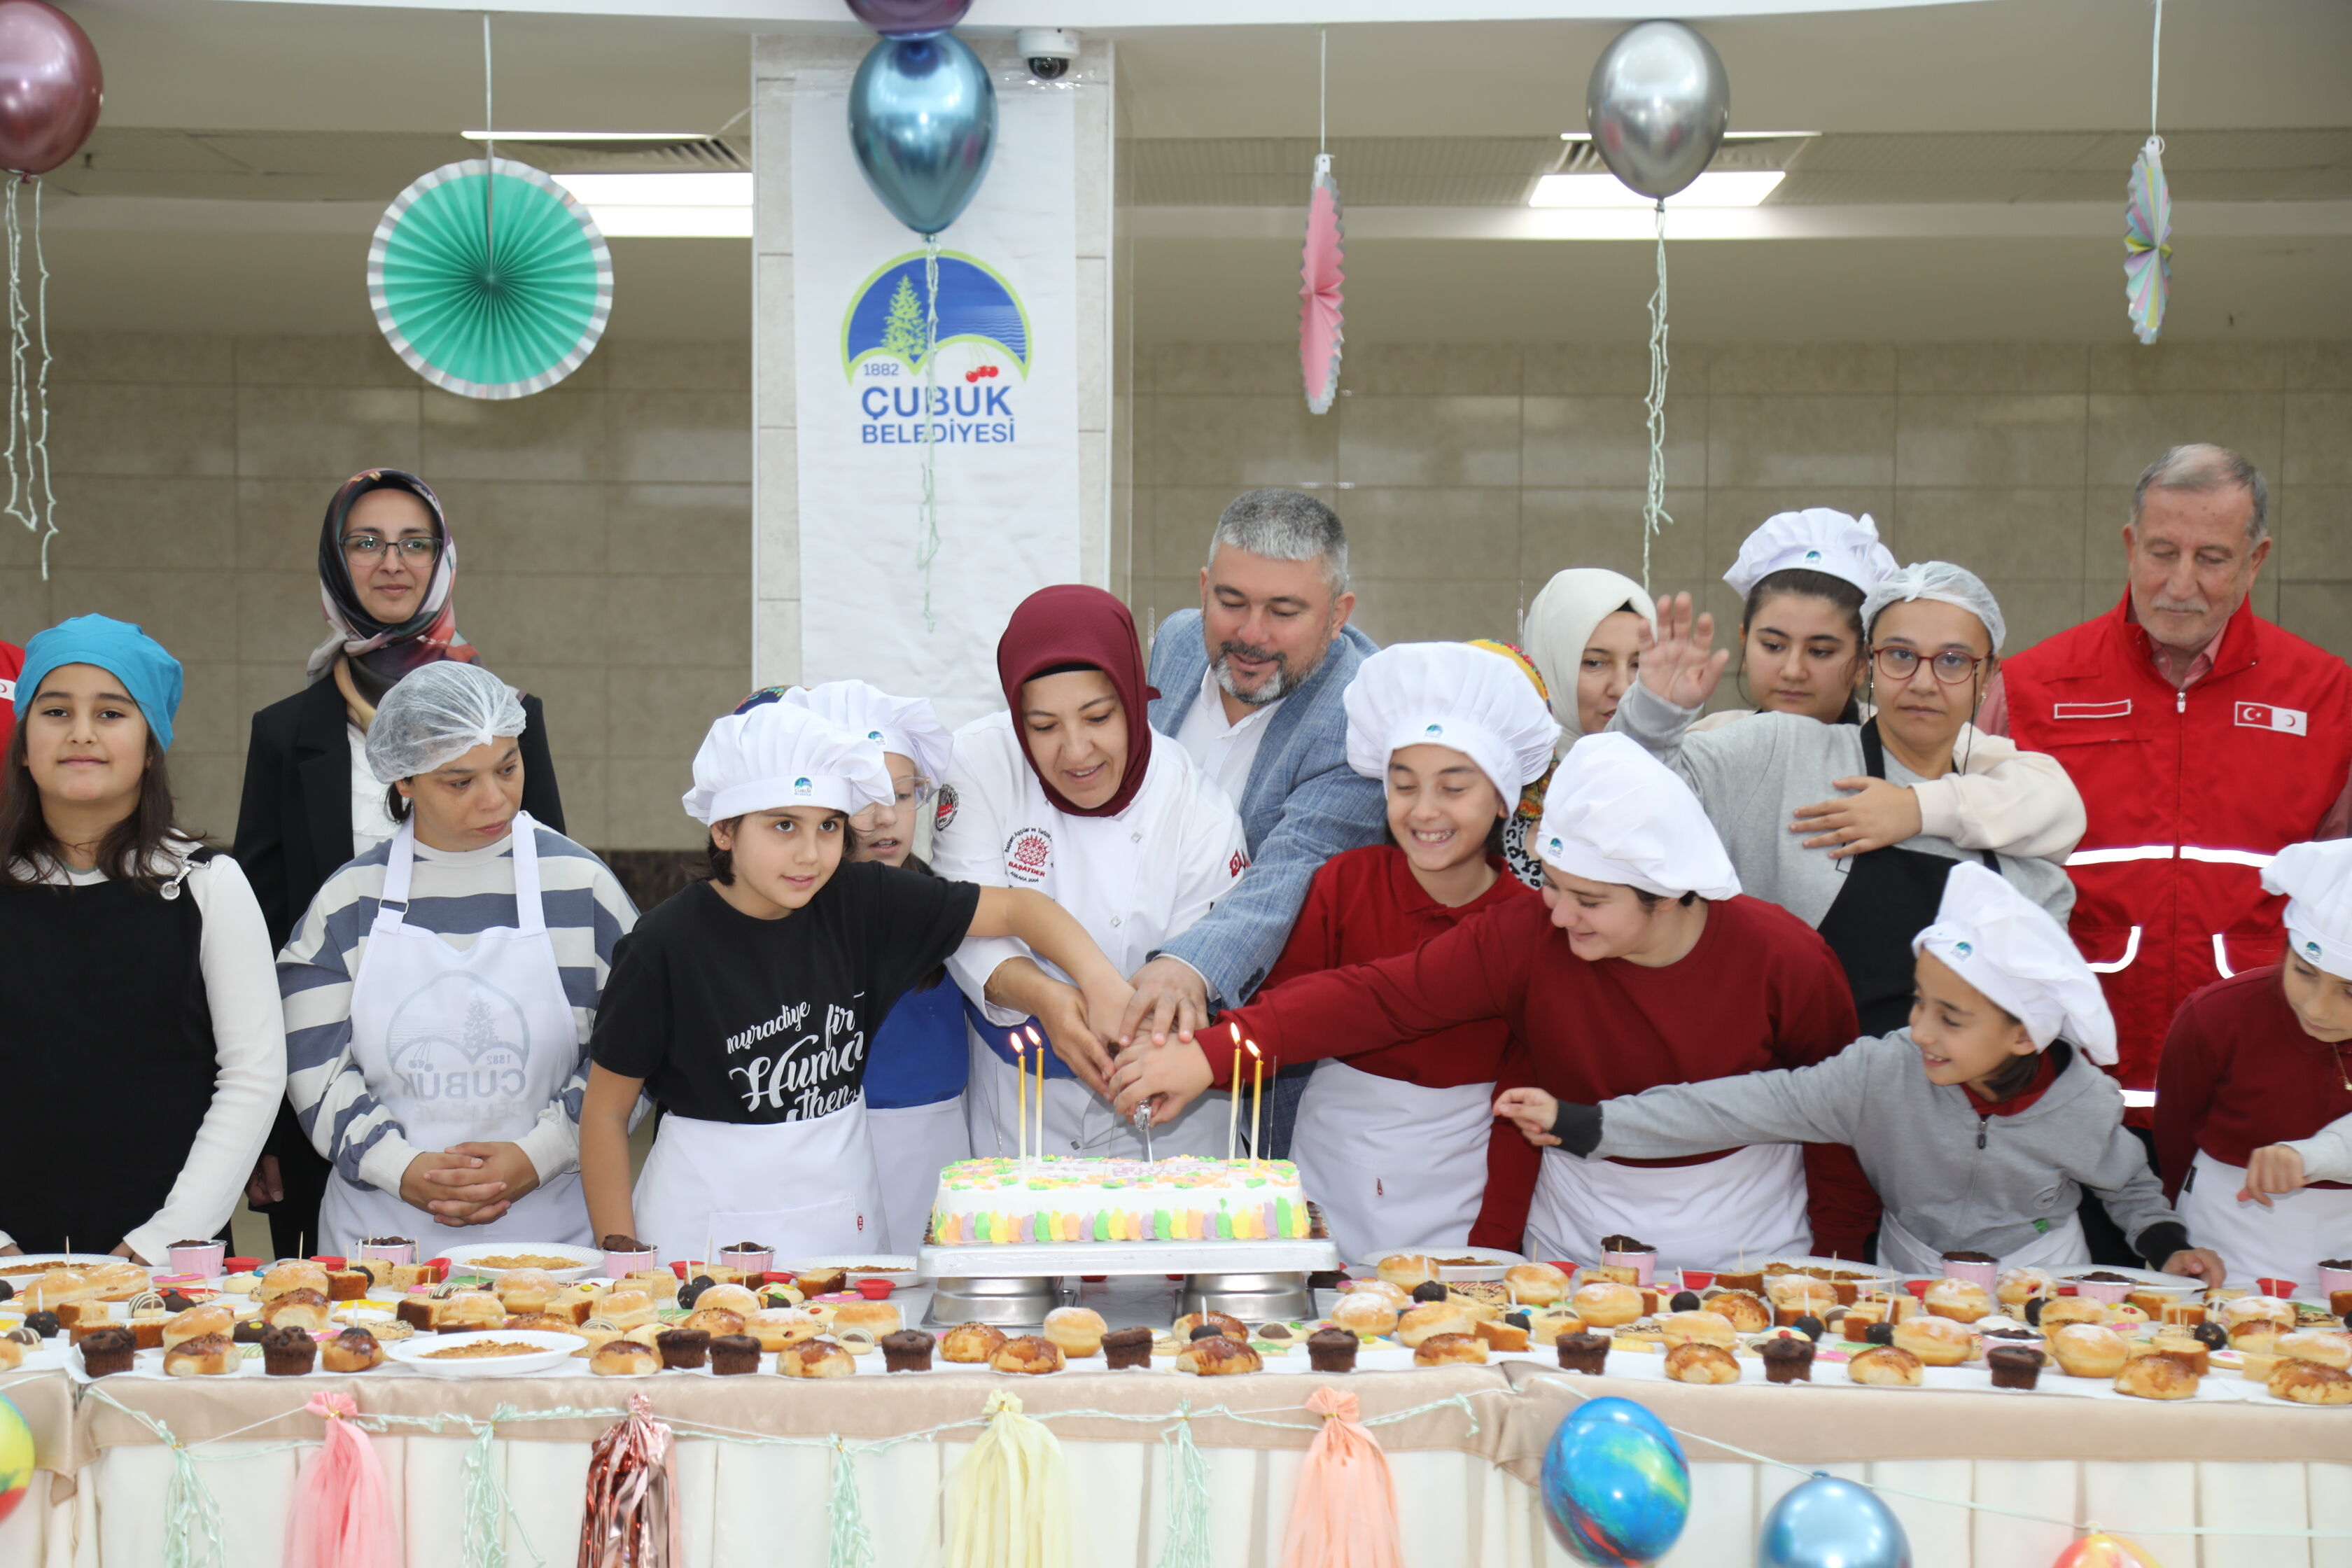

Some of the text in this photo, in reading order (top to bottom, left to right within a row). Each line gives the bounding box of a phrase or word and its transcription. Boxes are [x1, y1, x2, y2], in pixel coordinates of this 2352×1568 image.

[863, 363, 899, 376] 1882
[862, 386, 1013, 421] ÇUBUK
[862, 418, 1015, 443] BELEDİYESİ
[1010, 872, 1027, 881] ANKARA
